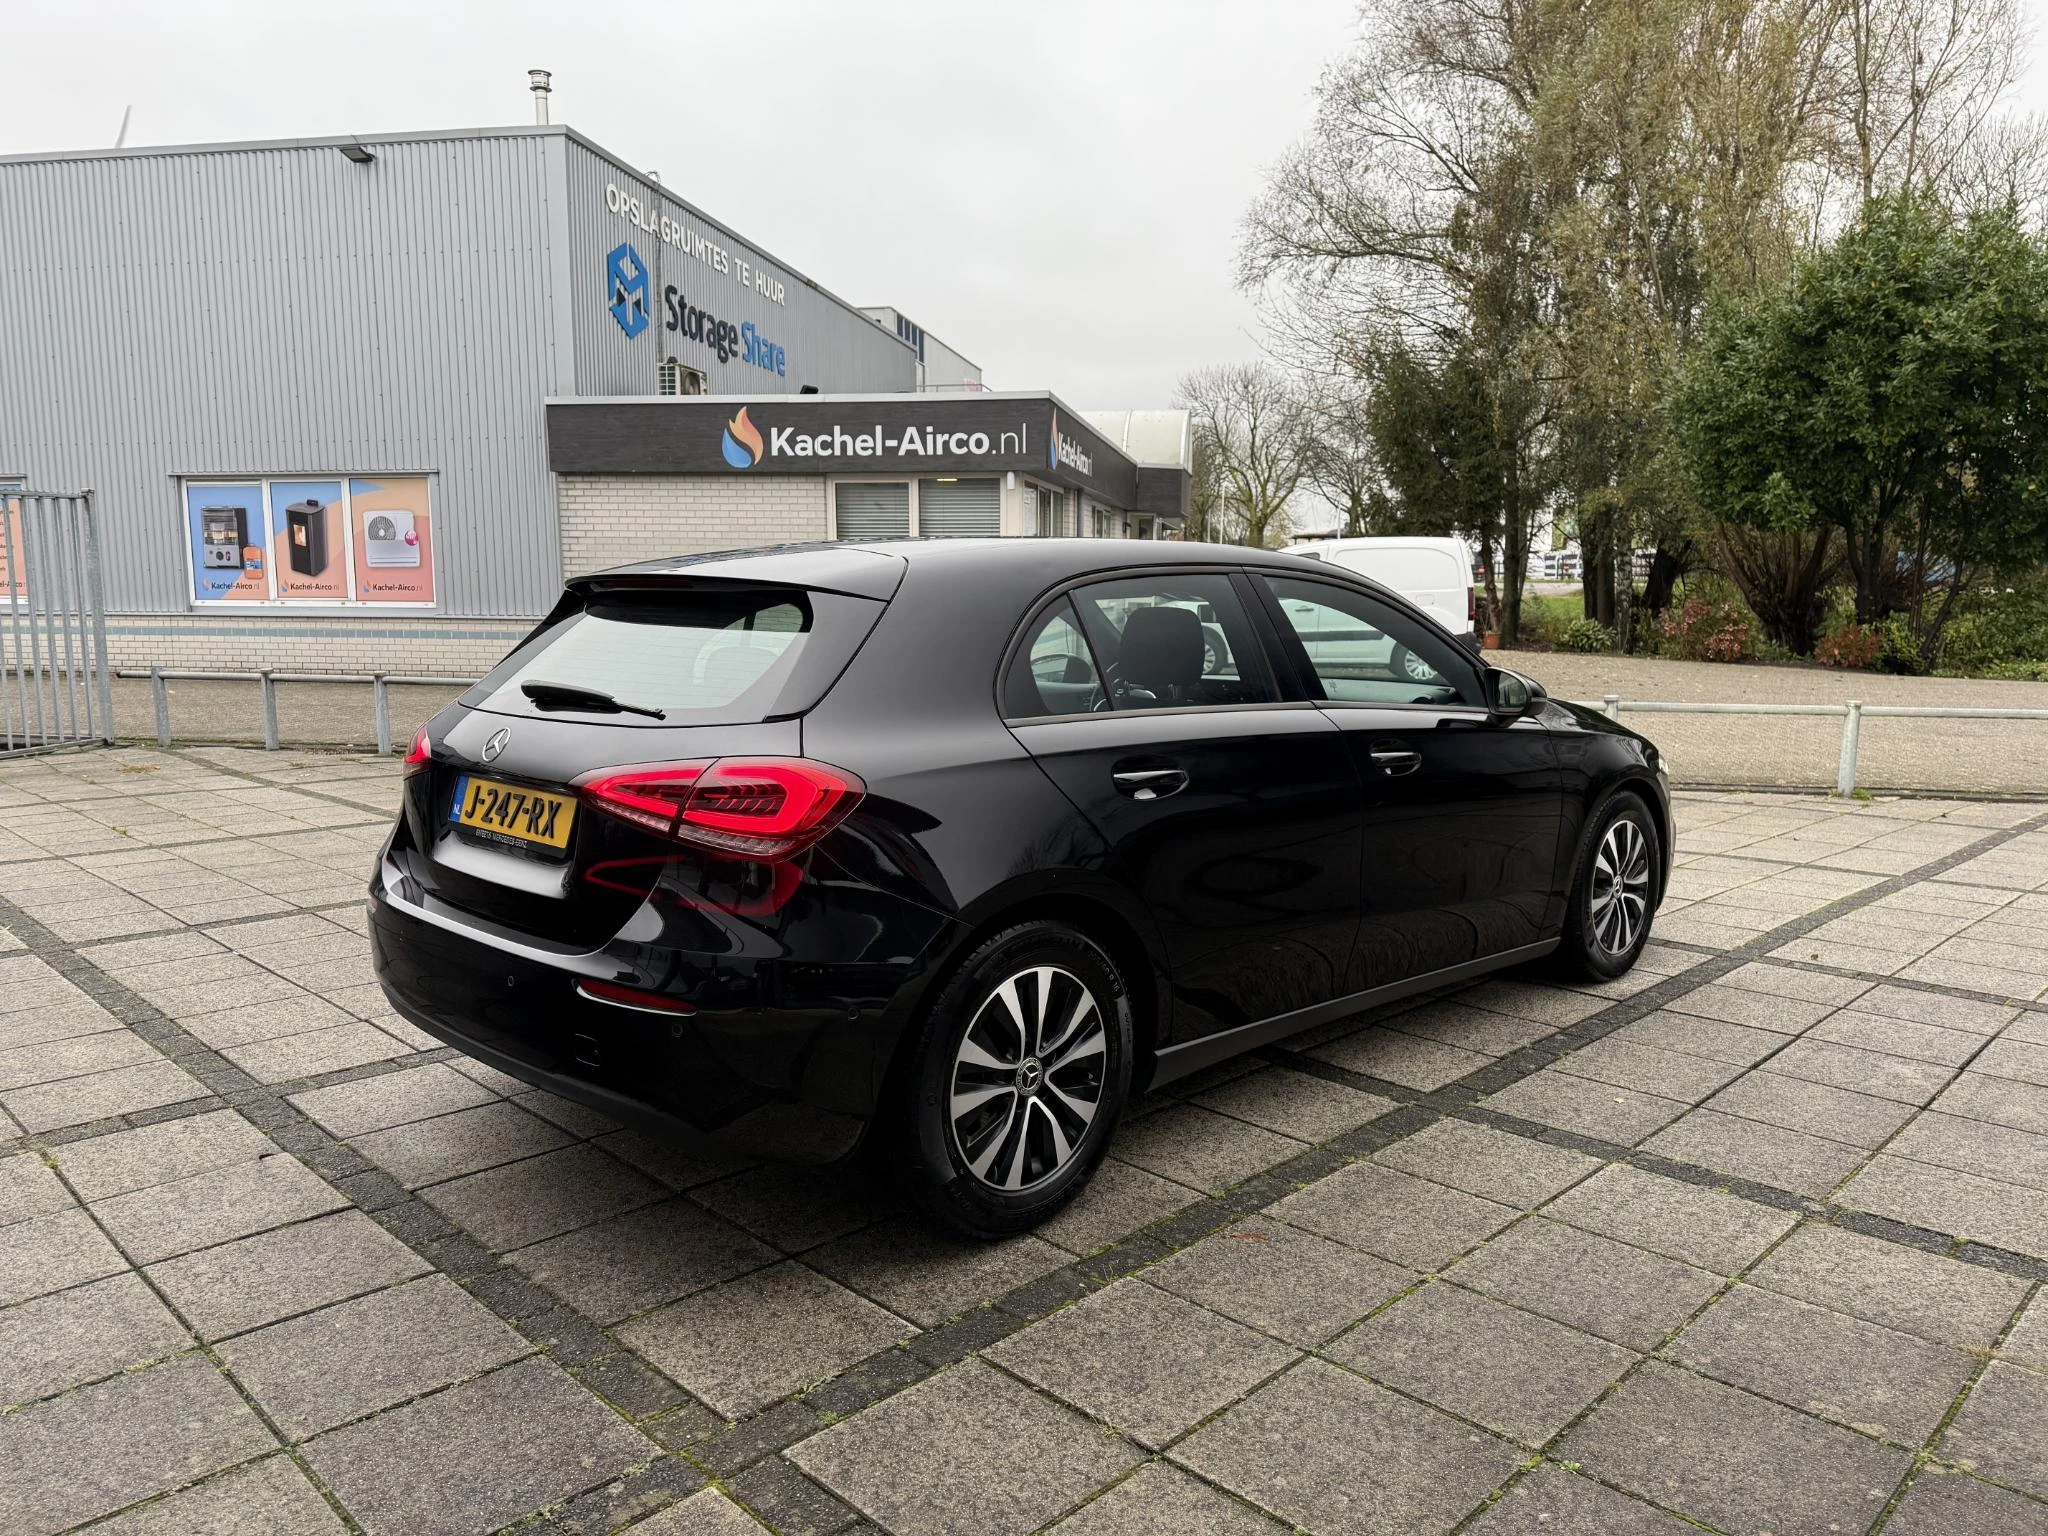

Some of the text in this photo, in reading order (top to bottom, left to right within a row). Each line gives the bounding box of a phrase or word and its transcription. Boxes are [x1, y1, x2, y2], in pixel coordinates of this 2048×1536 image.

[606, 183, 785, 306] OPSLAGRUIMTES TE HUUR
[665, 284, 785, 377] Storage Share
[770, 423, 1027, 457] Kachel-Airco.nl
[464, 785, 562, 839] J-247-RX
